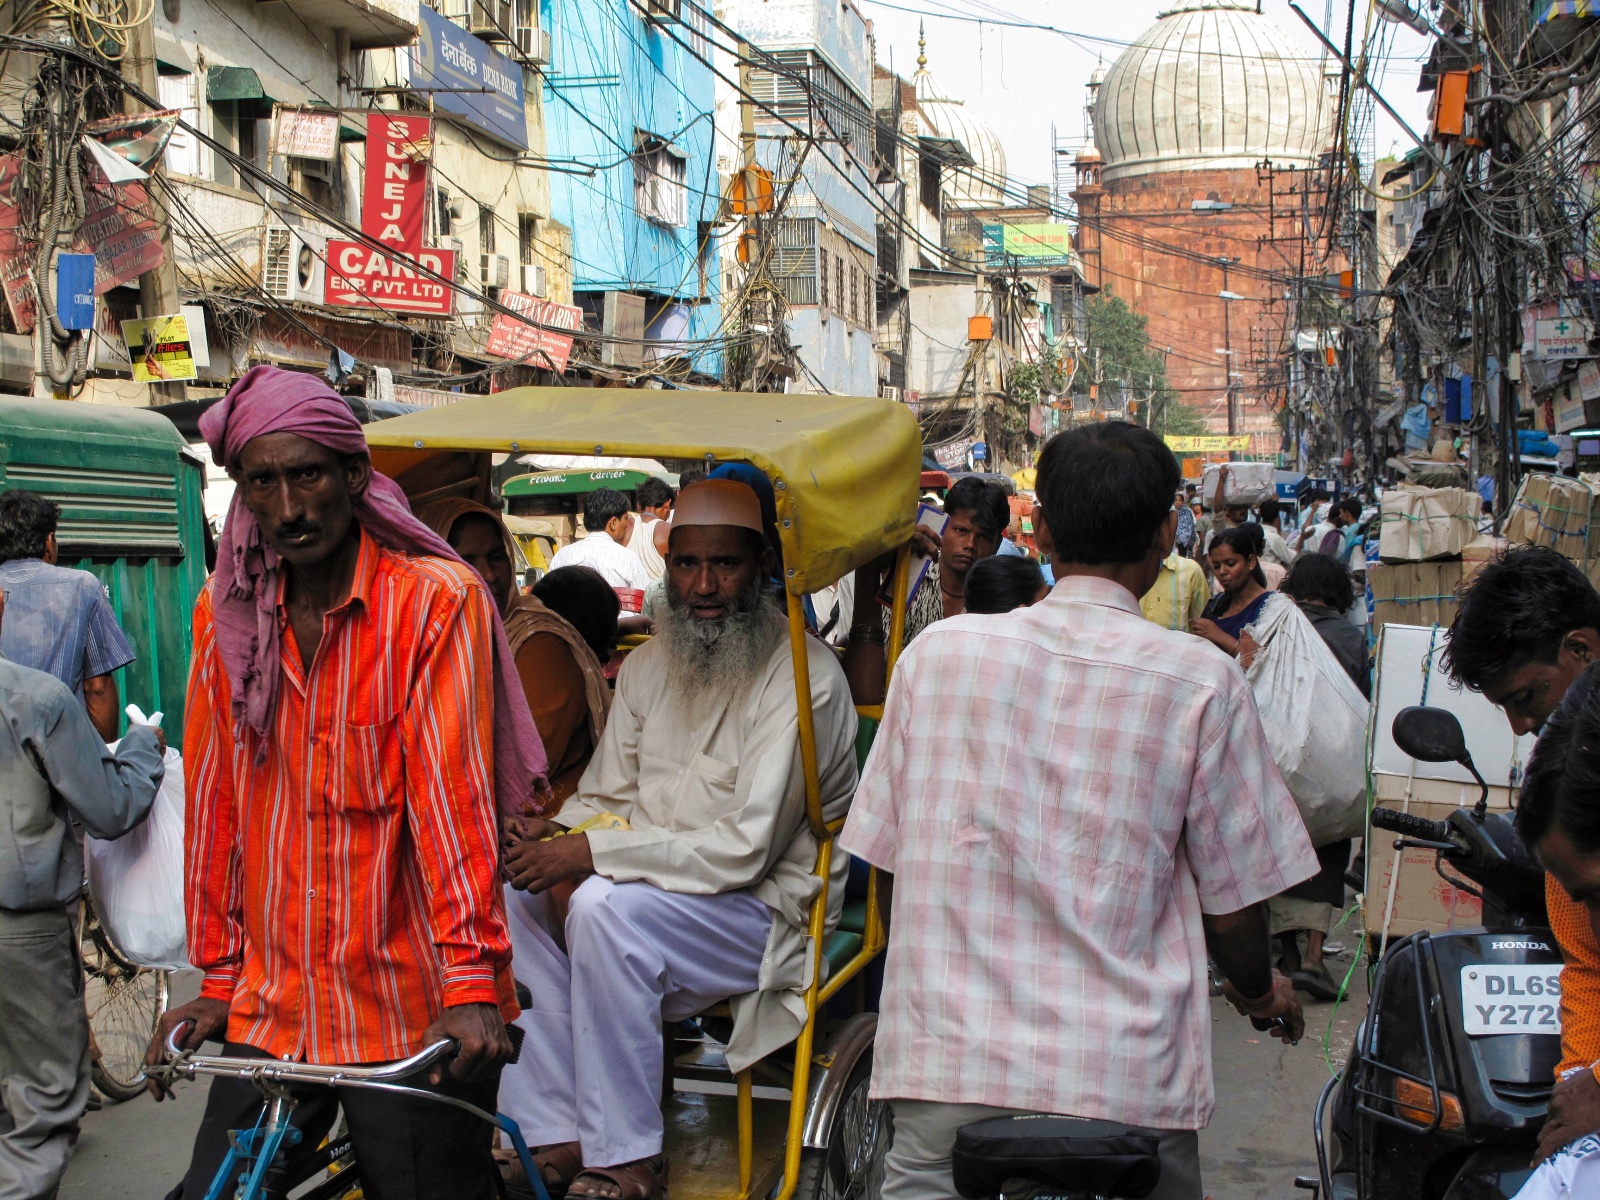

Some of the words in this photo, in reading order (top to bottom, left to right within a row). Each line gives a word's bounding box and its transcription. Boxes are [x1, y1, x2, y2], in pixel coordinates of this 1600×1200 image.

[482, 62, 501, 91] DENA
[501, 73, 518, 101] BANK
[379, 120, 409, 242] SUNEJA
[340, 247, 442, 281] CARD
[330, 276, 367, 292] EMP.
[372, 280, 407, 296] PVT.
[412, 284, 444, 298] LTD
[504, 293, 544, 323] CHETAN
[543, 303, 577, 330] CARDS
[158, 344, 184, 352] Files
[1491, 942, 1550, 950] HONDA
[1485, 976, 1561, 996] DL6S
